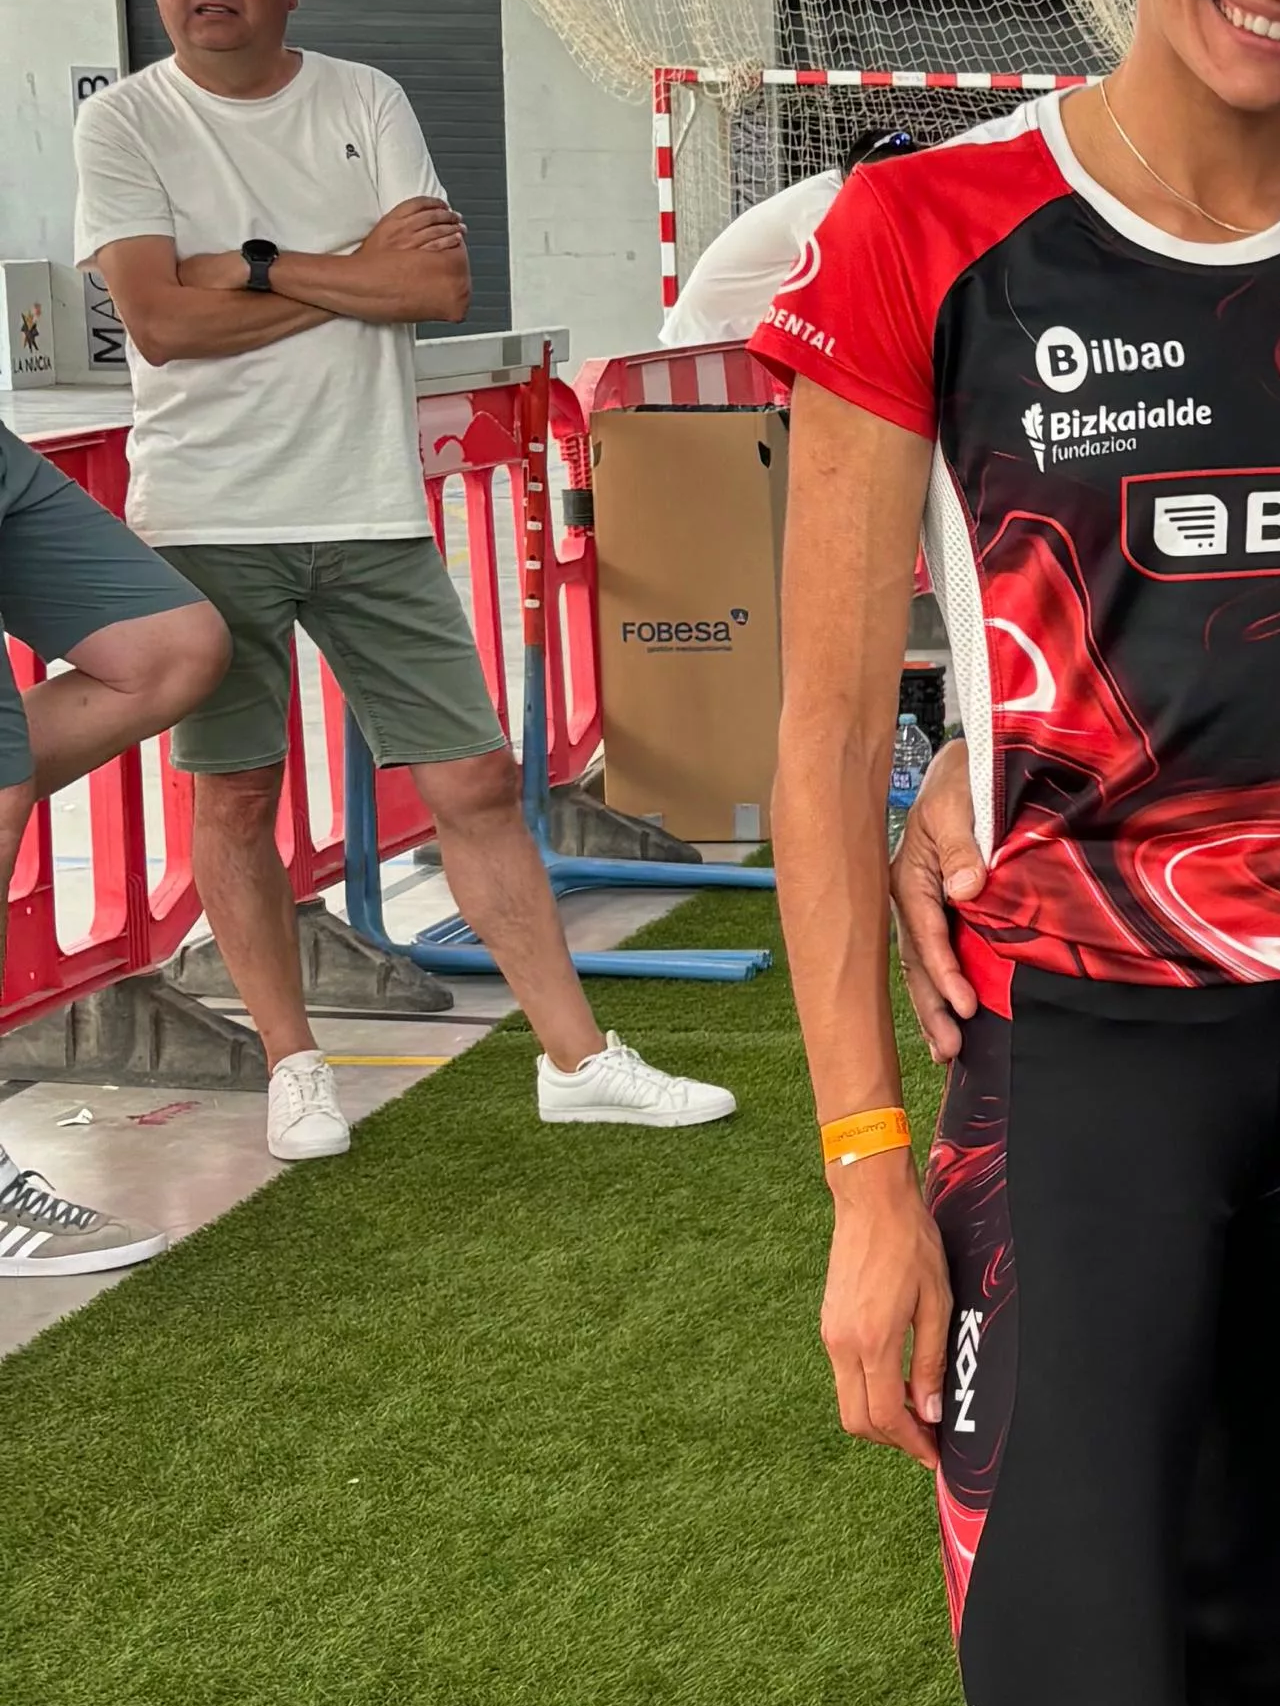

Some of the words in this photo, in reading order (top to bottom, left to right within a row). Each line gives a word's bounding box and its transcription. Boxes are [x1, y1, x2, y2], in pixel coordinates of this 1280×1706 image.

[1047, 337, 1186, 379] Bilbao
[1050, 397, 1213, 442] Bizkaialde
[1051, 437, 1137, 464] fundazioa
